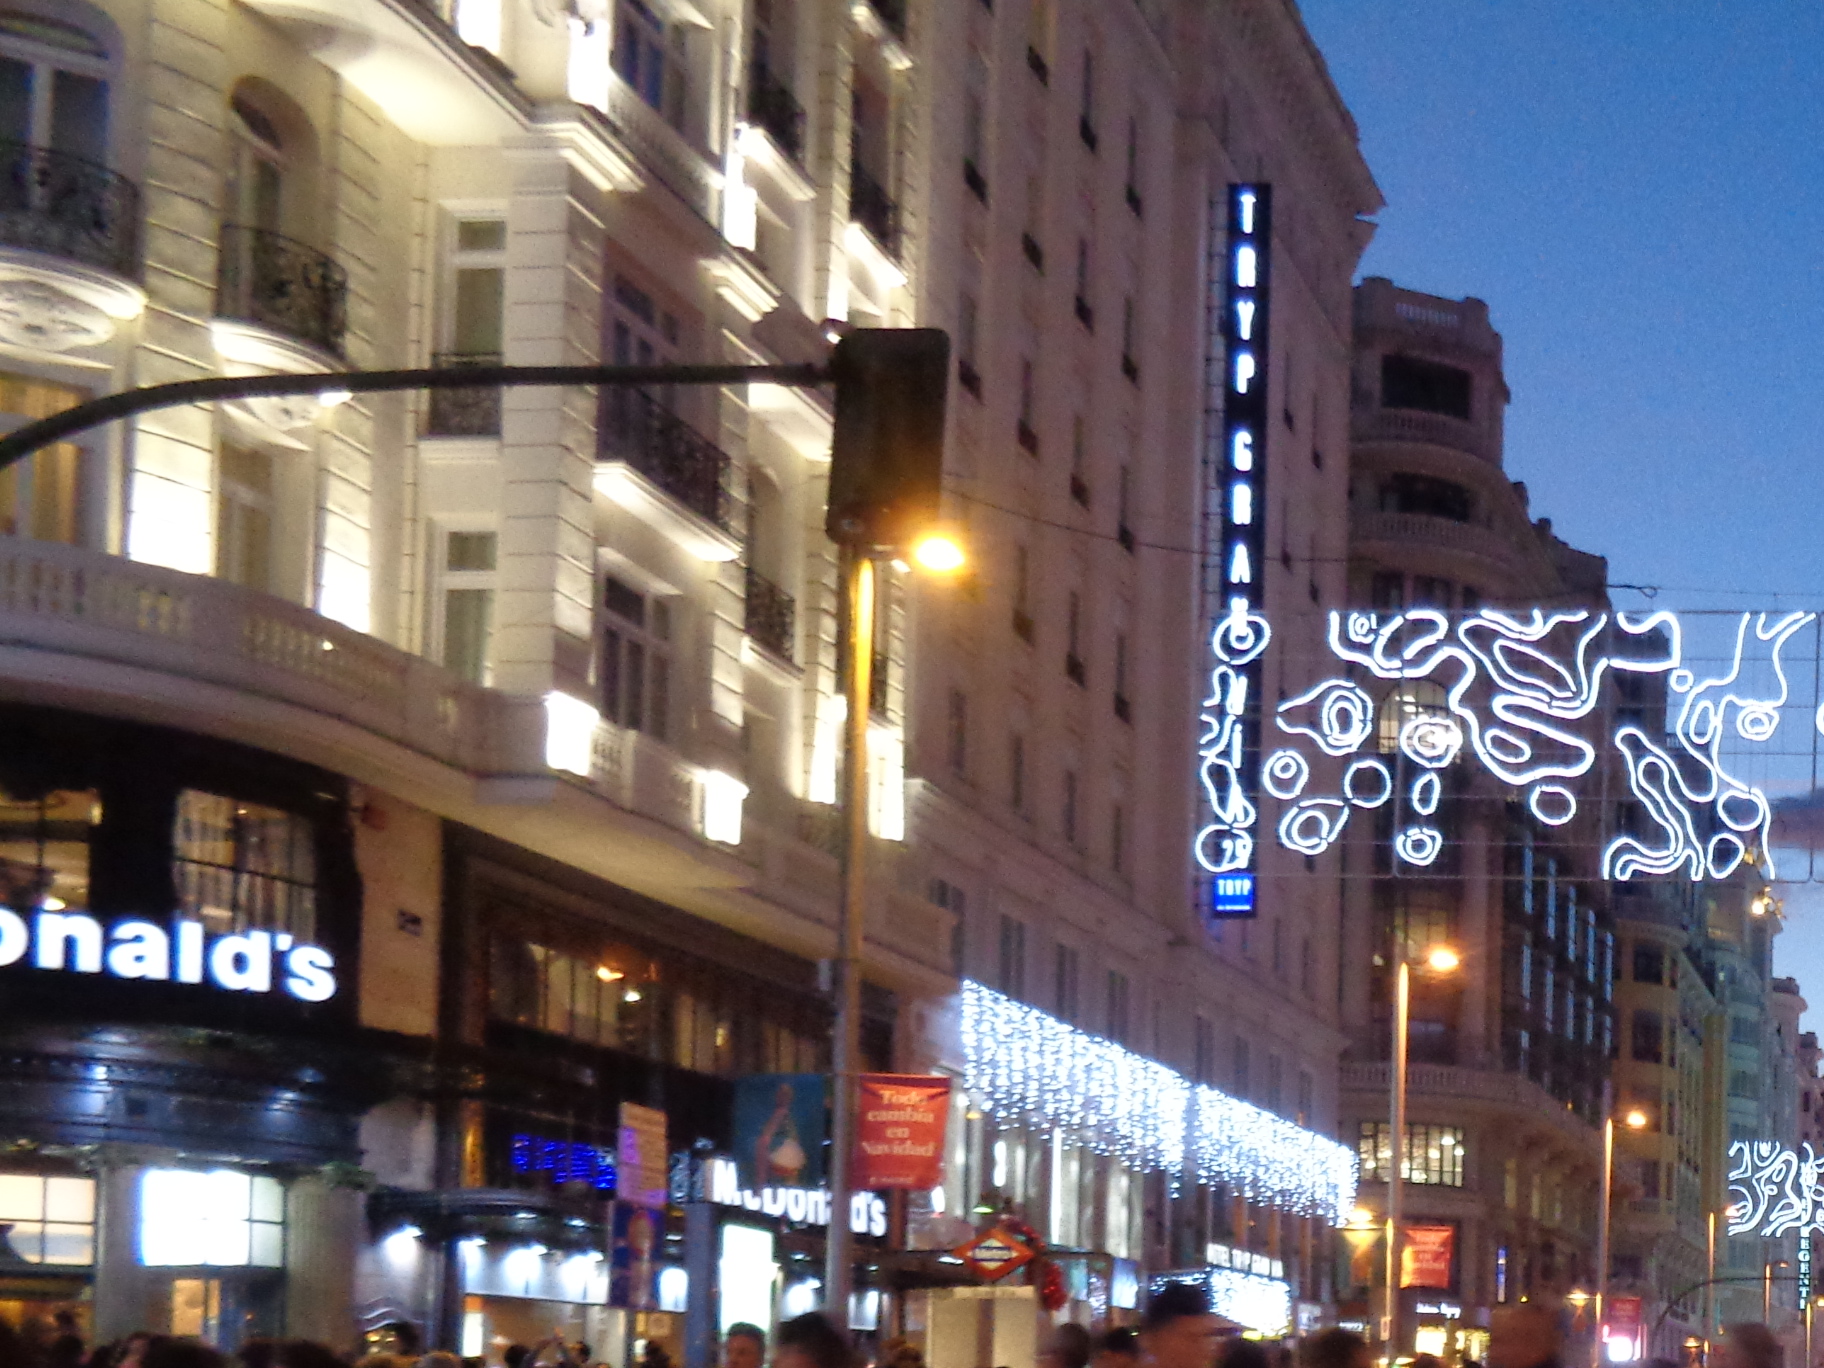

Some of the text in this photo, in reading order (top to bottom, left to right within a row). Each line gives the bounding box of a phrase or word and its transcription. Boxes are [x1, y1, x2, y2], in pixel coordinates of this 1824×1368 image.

[1236, 194, 1257, 394] TRYP
[867, 1107, 934, 1123] cambia
[880, 1090, 927, 1105] Todo
[713, 1159, 887, 1237] McDond's
